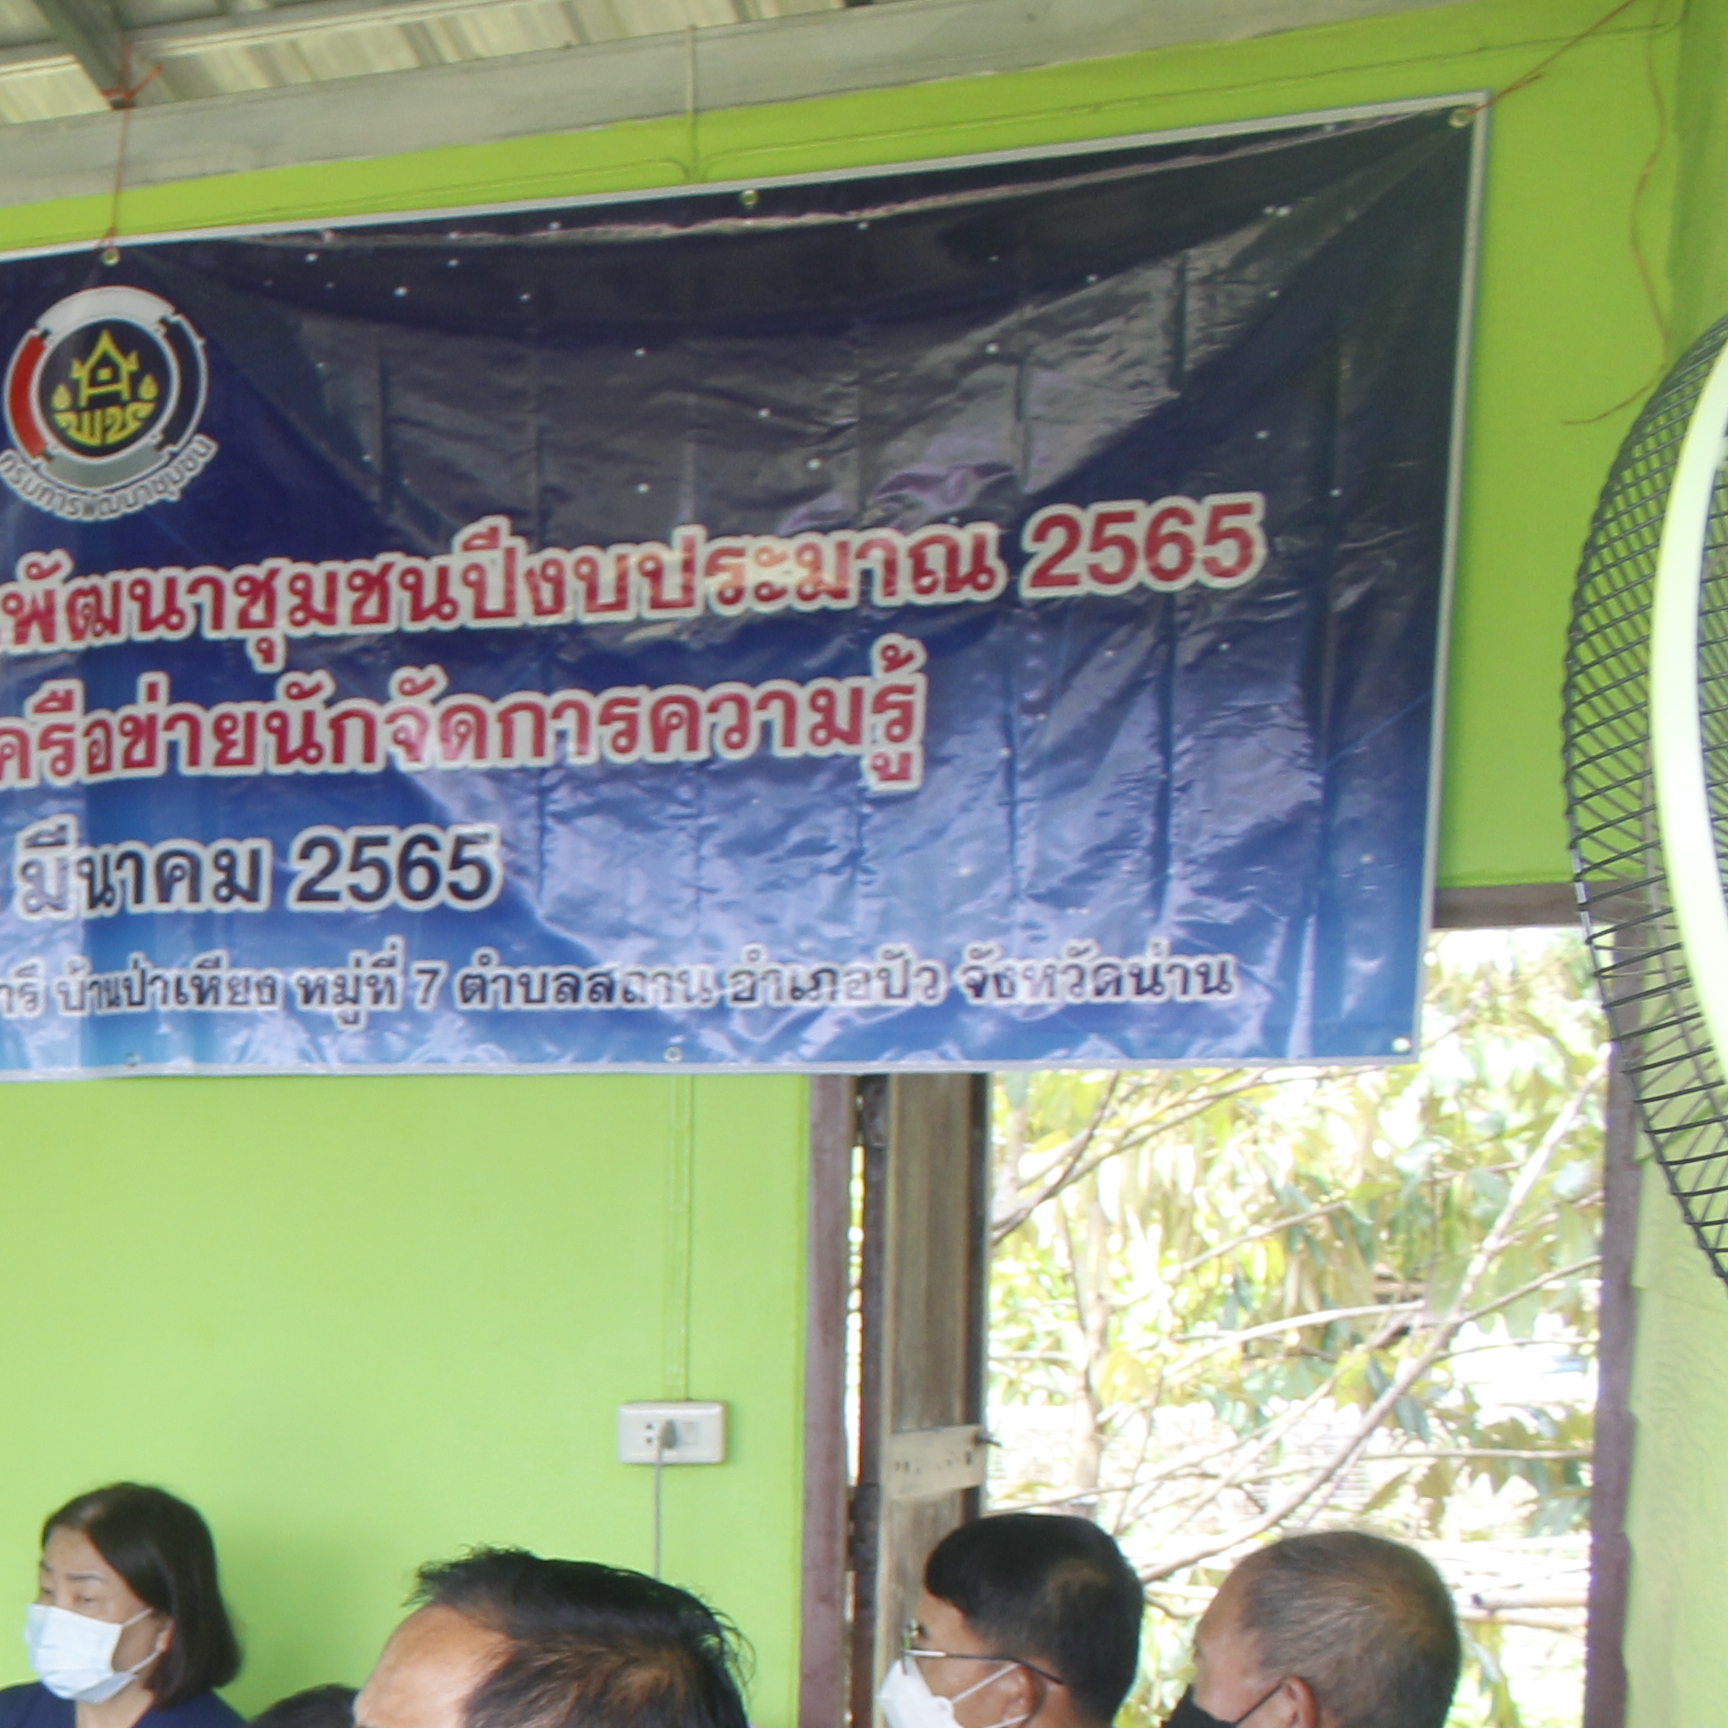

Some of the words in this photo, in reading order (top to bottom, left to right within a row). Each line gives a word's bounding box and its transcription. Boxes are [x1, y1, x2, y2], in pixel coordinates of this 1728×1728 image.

[1029, 500, 1256, 591] 2565
[21, 820, 265, 913] มีนาคม
[296, 832, 496, 905] 2565
[296, 940, 399, 1026] หมู่ที่
[417, 965, 441, 1005] 7
[728, 947, 941, 1002] อำเภอปัว
